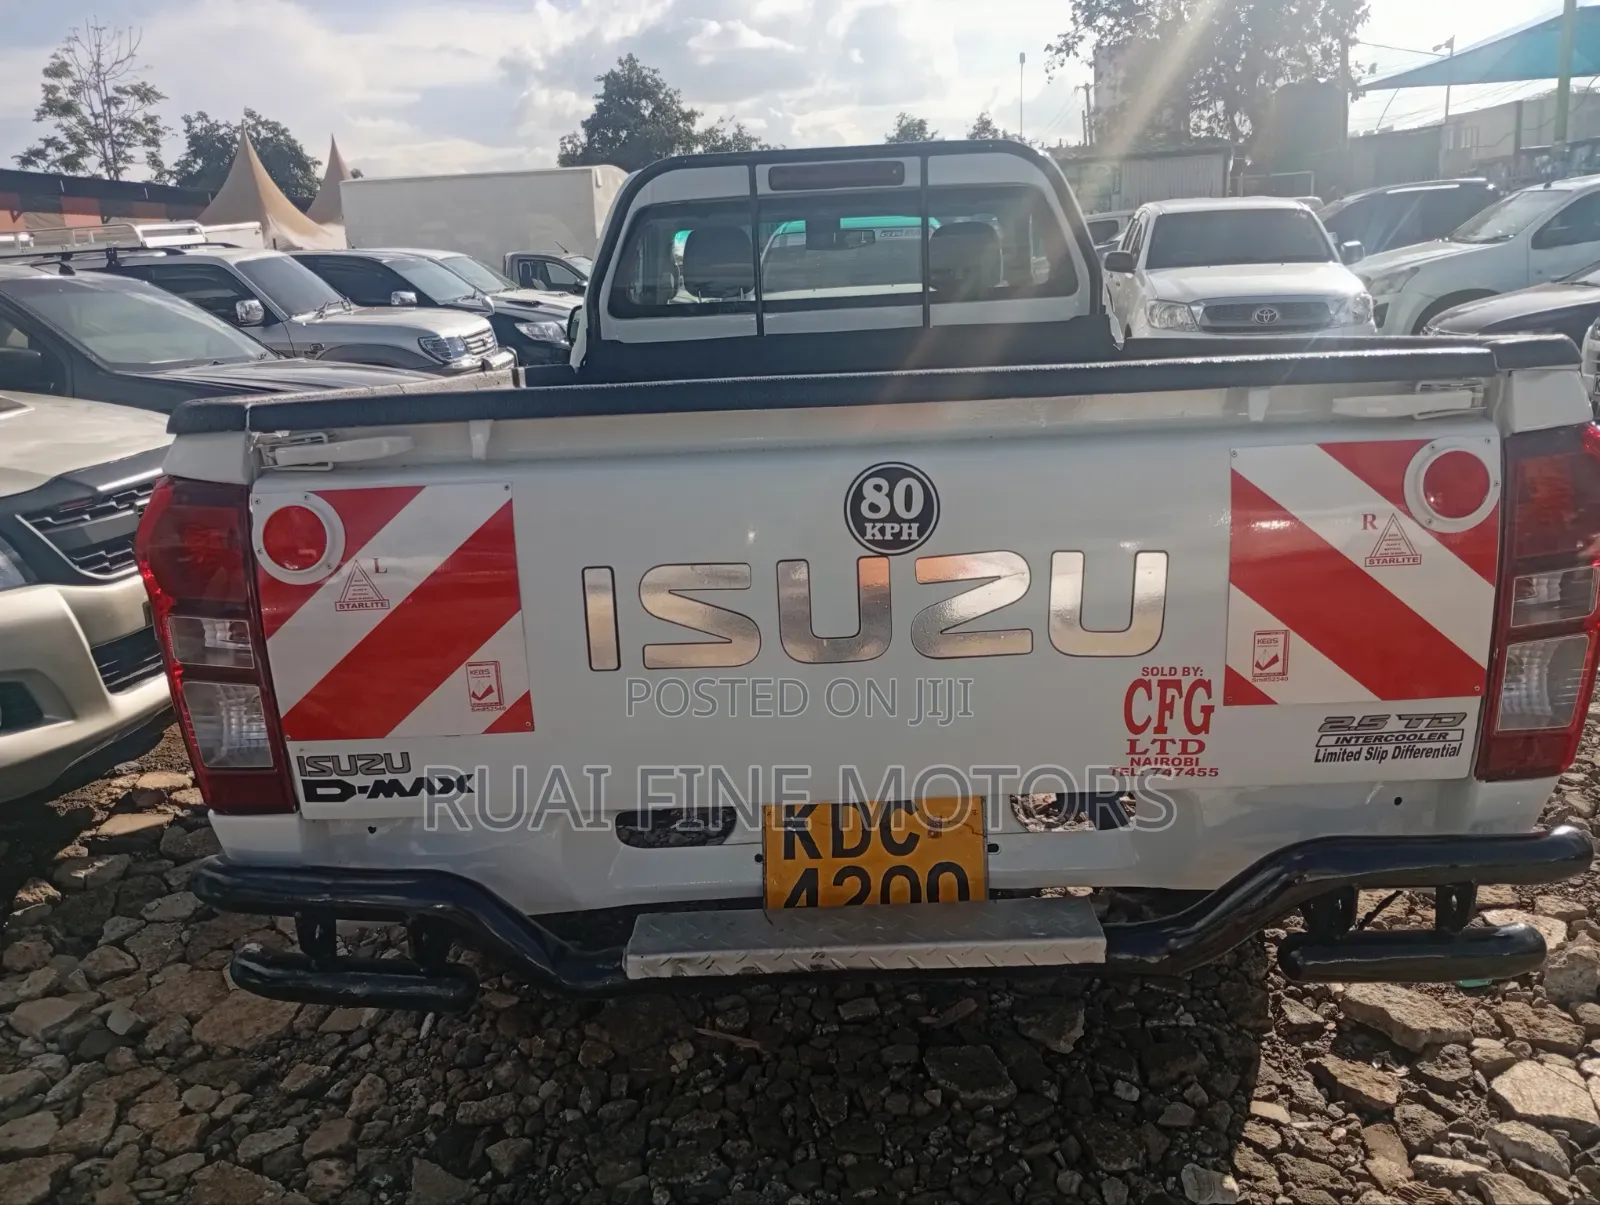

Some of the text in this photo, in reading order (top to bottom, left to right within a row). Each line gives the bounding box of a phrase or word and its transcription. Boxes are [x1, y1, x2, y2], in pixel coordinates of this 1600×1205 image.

[860, 477, 924, 519] 80
[1361, 513, 1378, 530] R
[864, 522, 919, 540] KPH
[372, 557, 388, 573] L
[1368, 556, 1419, 565] STARLITE
[338, 601, 387, 609] STARLITE
[581, 549, 1170, 672] ISUZU
[1141, 666, 1204, 677] SOLD BY:
[1123, 678, 1215, 736] CFG
[1318, 712, 1468, 733] 2.5 TD
[1126, 738, 1206, 756] LTD
[1334, 732, 1449, 745] INTERCOOLER
[1130, 757, 1200, 767] NAIROBI
[1314, 743, 1462, 764] Limited Slip Differential
[296, 752, 412, 777] ISUZU
[1150, 767, 1219, 777] 747455
[301, 774, 475, 803] D-MAX
[783, 800, 921, 860] KDC
